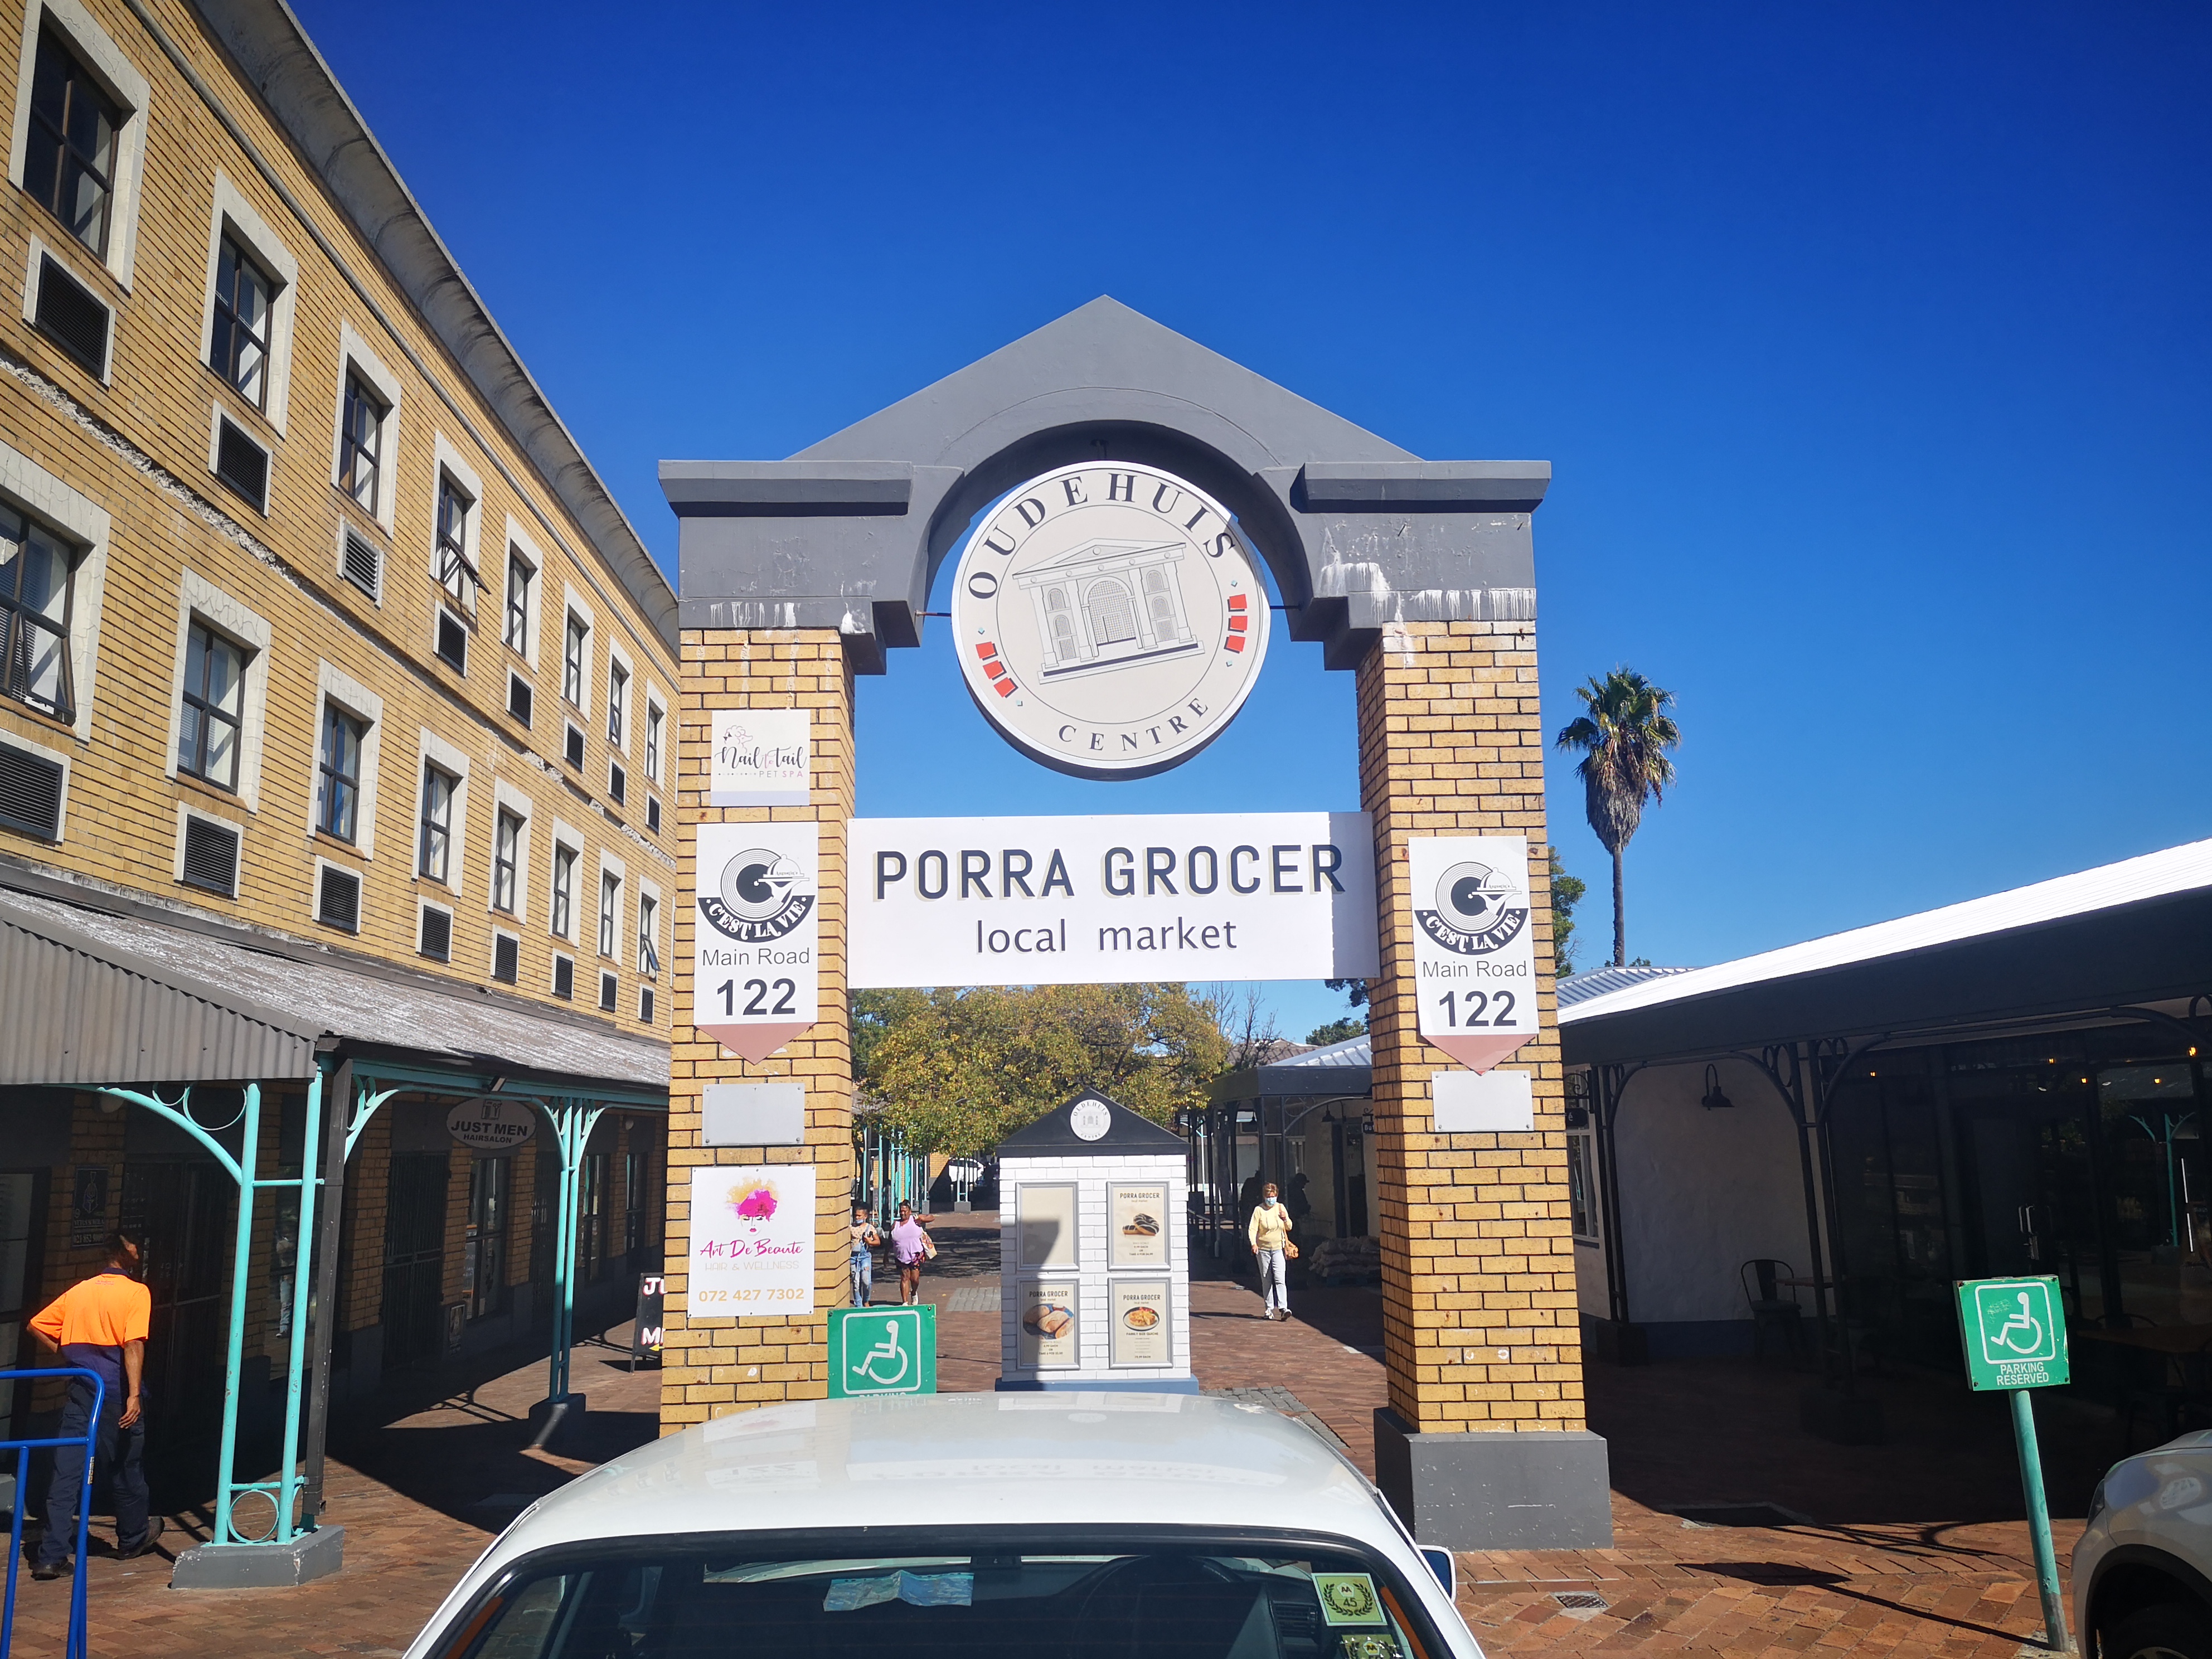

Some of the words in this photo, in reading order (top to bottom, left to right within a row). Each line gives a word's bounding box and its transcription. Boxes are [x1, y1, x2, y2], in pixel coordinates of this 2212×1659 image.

[968, 472, 1236, 599] OUDEHUIS
[1058, 697, 1209, 751] CENTRE
[873, 847, 1075, 901] PORRA
[1102, 843, 1345, 896] GROCER
[709, 903, 752, 940] C'EST
[754, 921, 782, 938] LA
[775, 900, 806, 928] VIE
[976, 918, 1066, 954] local
[1099, 916, 1238, 951] market
[1426, 916, 1468, 953] C'EST
[1471, 934, 1498, 950] LA
[1491, 914, 1520, 940] VIE
[702, 949, 749, 967] Main
[758, 948, 809, 965] Road
[1423, 961, 1468, 978] Main
[1477, 960, 1527, 977] Road
[717, 978, 796, 1016] 122
[1438, 990, 1517, 1027] 122
[1073, 1102, 1108, 1116] OUDEHUIS
[451, 1121, 492, 1133] JUST
[494, 1124, 527, 1136] MEN
[463, 1134, 512, 1144] HAIRSALON
[700, 1240, 731, 1258] Art
[730, 1239, 753, 1258] De
[754, 1238, 806, 1257] Beaute
[705, 1263, 727, 1271] HAIR
[743, 1260, 799, 1270] WELLNESS
[698, 1291, 727, 1302] 072
[733, 1289, 761, 1301] 427
[767, 1288, 804, 1301] 7302
[2000, 1362, 2044, 1375] PARKING
[1996, 1372, 2049, 1385] RESERVED
[1343, 1598, 1357, 1607] 45
